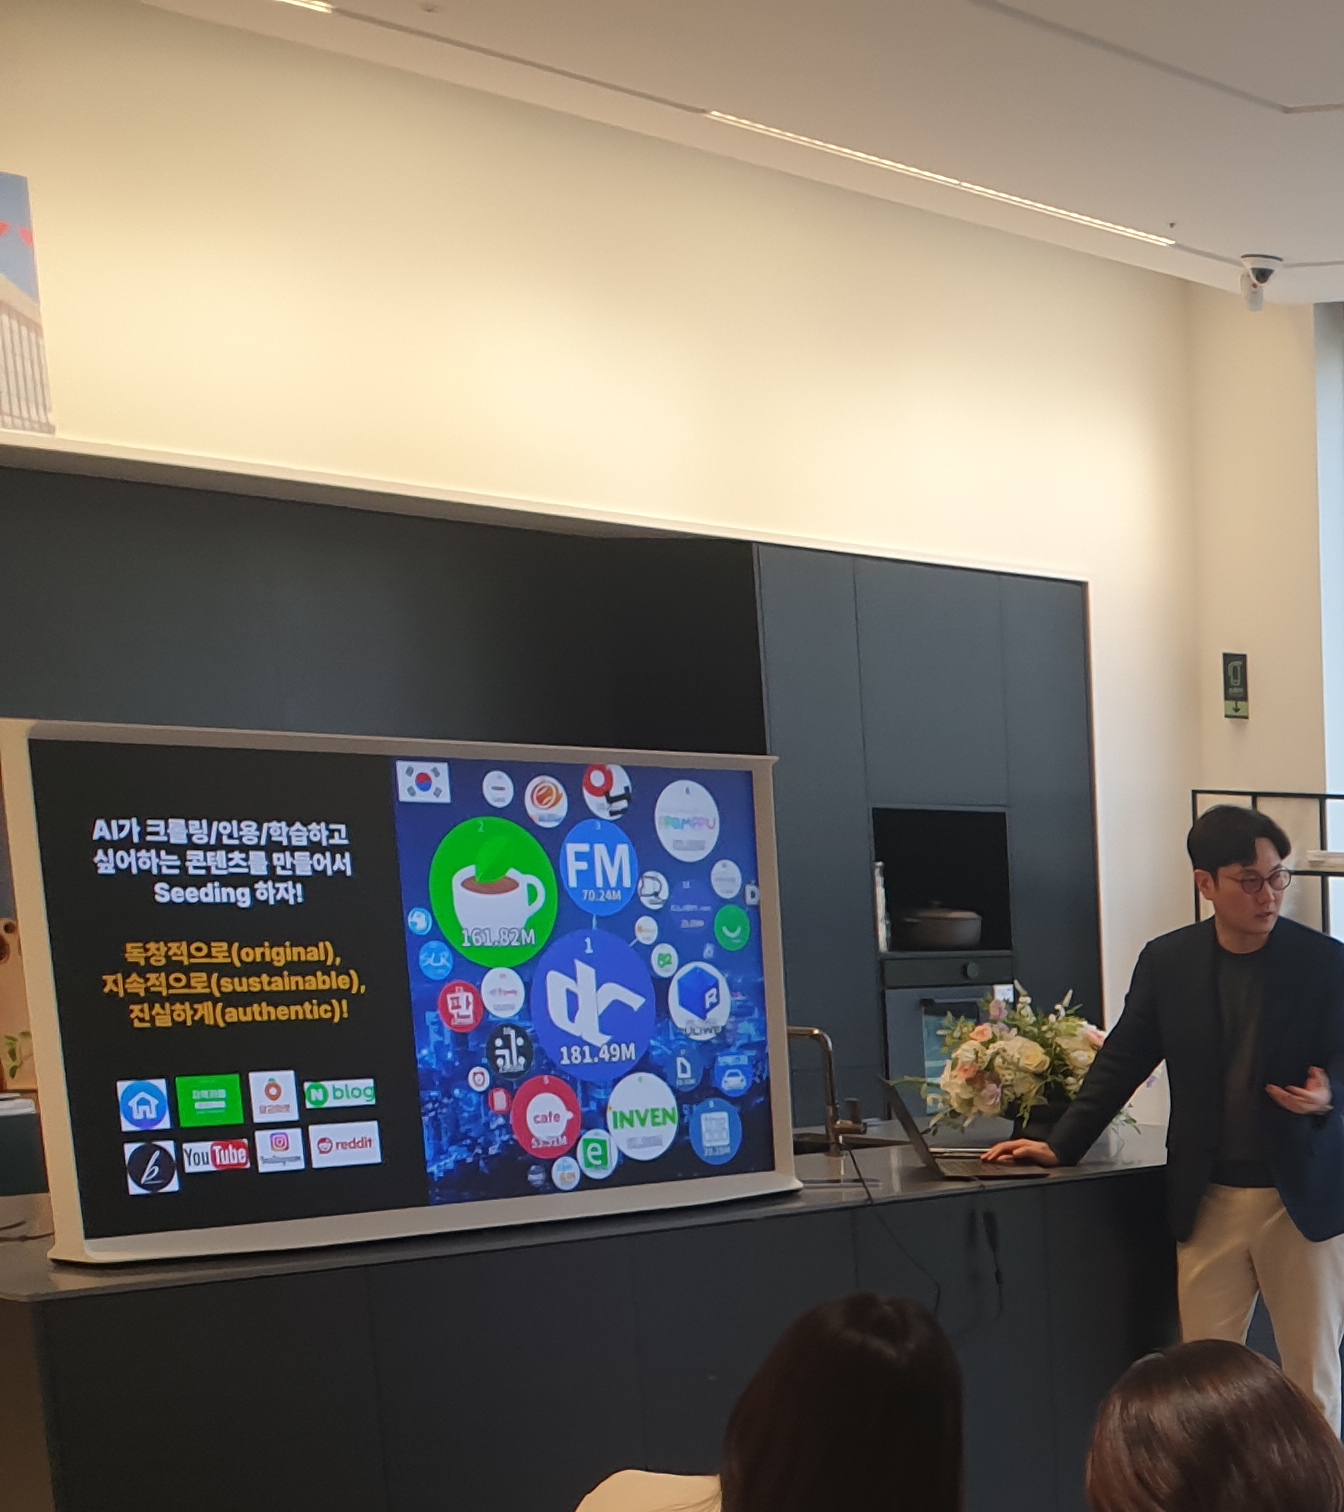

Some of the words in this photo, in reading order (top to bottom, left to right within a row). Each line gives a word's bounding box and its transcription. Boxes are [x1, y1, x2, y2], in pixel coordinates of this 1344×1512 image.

[92, 817, 141, 843] AI가
[93, 848, 181, 875] 싶어하는
[185, 850, 268, 876] 콘텐츠를
[272, 851, 352, 877] 만들어서
[565, 842, 632, 889] FM
[153, 882, 251, 907] Seeding
[254, 880, 303, 905] 하자!
[461, 927, 537, 947] 161.82M
[124, 941, 342, 968] 독창적으로(original),
[102, 969, 367, 998] 지속적으로(sustainable),
[129, 999, 349, 1028] 진실하게(authentic)!
[559, 1042, 637, 1066] 181.49M
[332, 1084, 375, 1103] blog
[533, 1110, 561, 1125] cafe
[612, 1107, 678, 1130] INVEN
[335, 1136, 373, 1151] reddit
